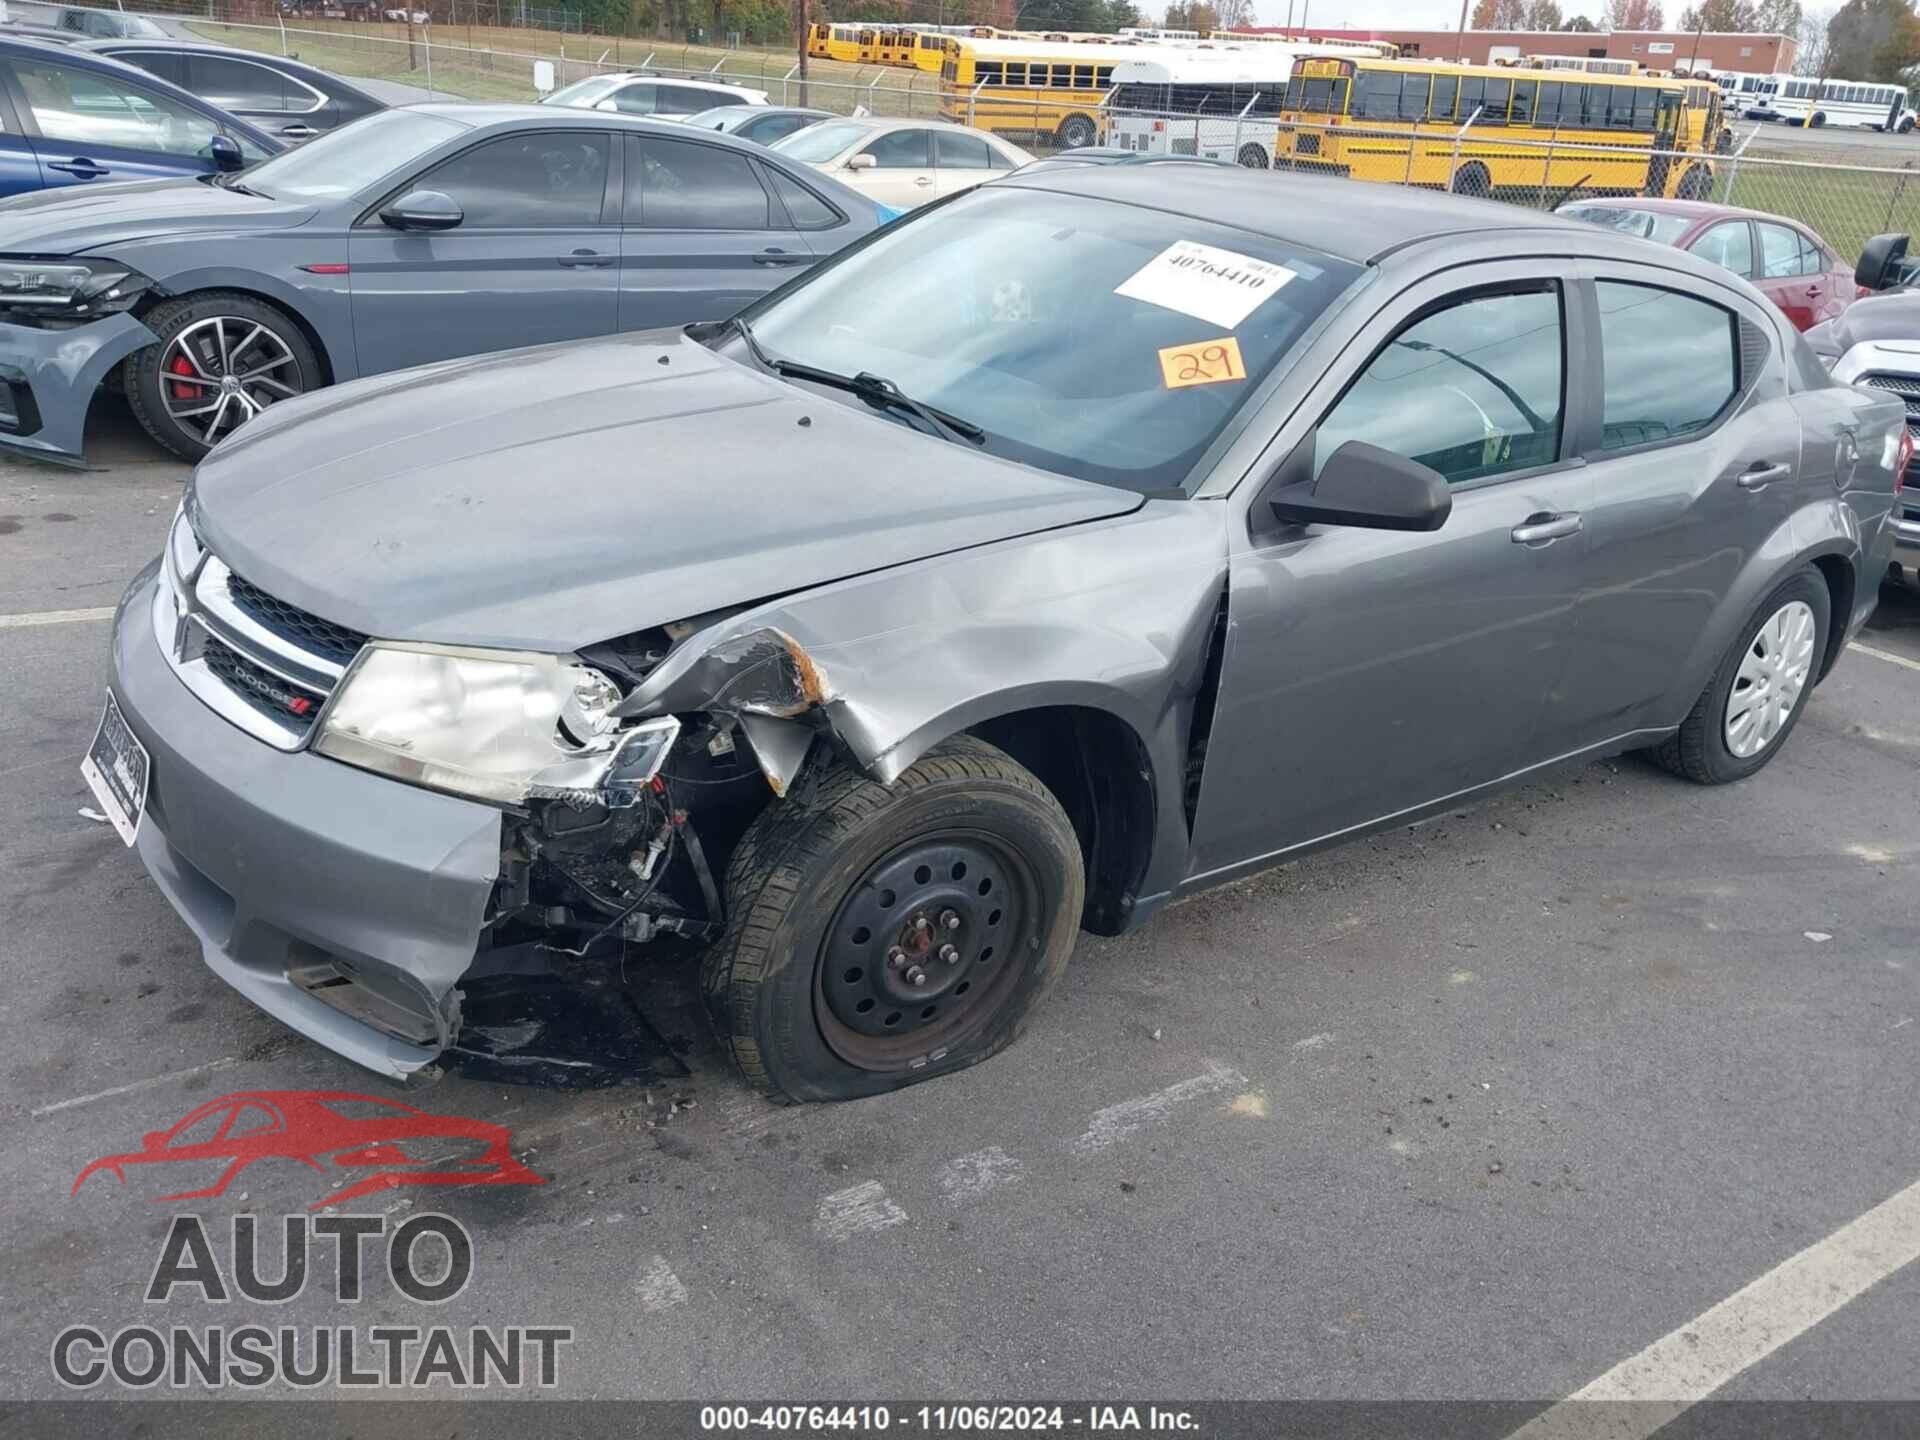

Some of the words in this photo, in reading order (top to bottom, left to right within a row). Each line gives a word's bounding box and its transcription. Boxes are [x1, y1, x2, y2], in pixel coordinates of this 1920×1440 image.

[1169, 255, 1265, 288] 40764410
[1171, 345, 1233, 380] 29
[235, 667, 293, 705] DODGE
